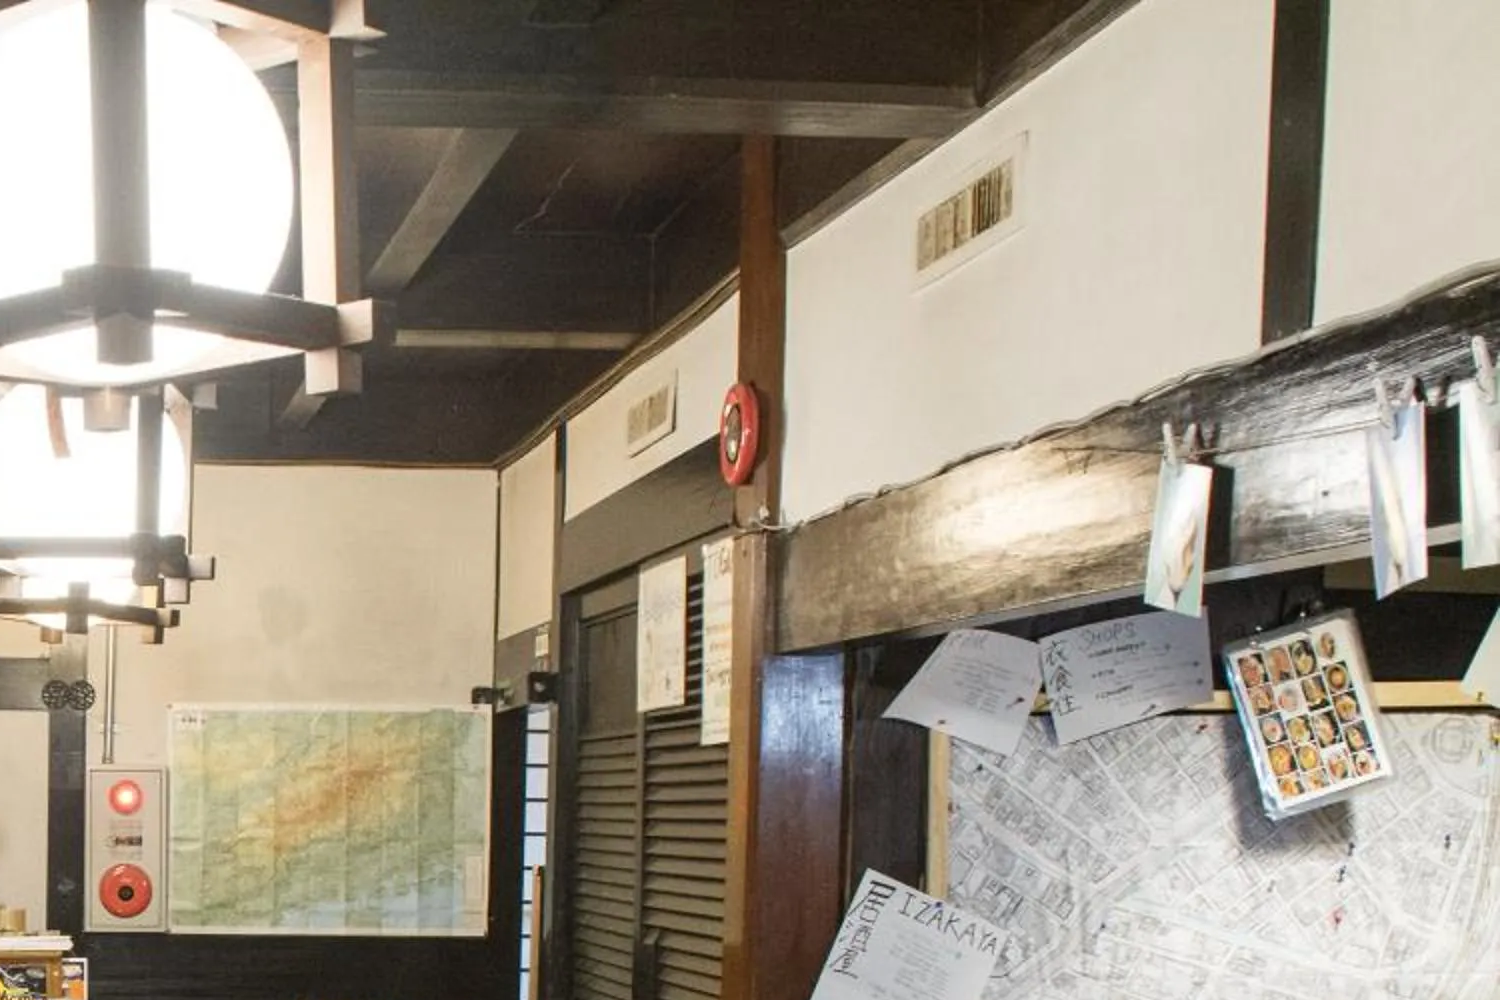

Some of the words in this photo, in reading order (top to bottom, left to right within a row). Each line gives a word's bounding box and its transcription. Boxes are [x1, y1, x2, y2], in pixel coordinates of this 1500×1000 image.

[1046, 640, 1083, 716] 衣食住
[898, 892, 998, 955] IZAKAYA
